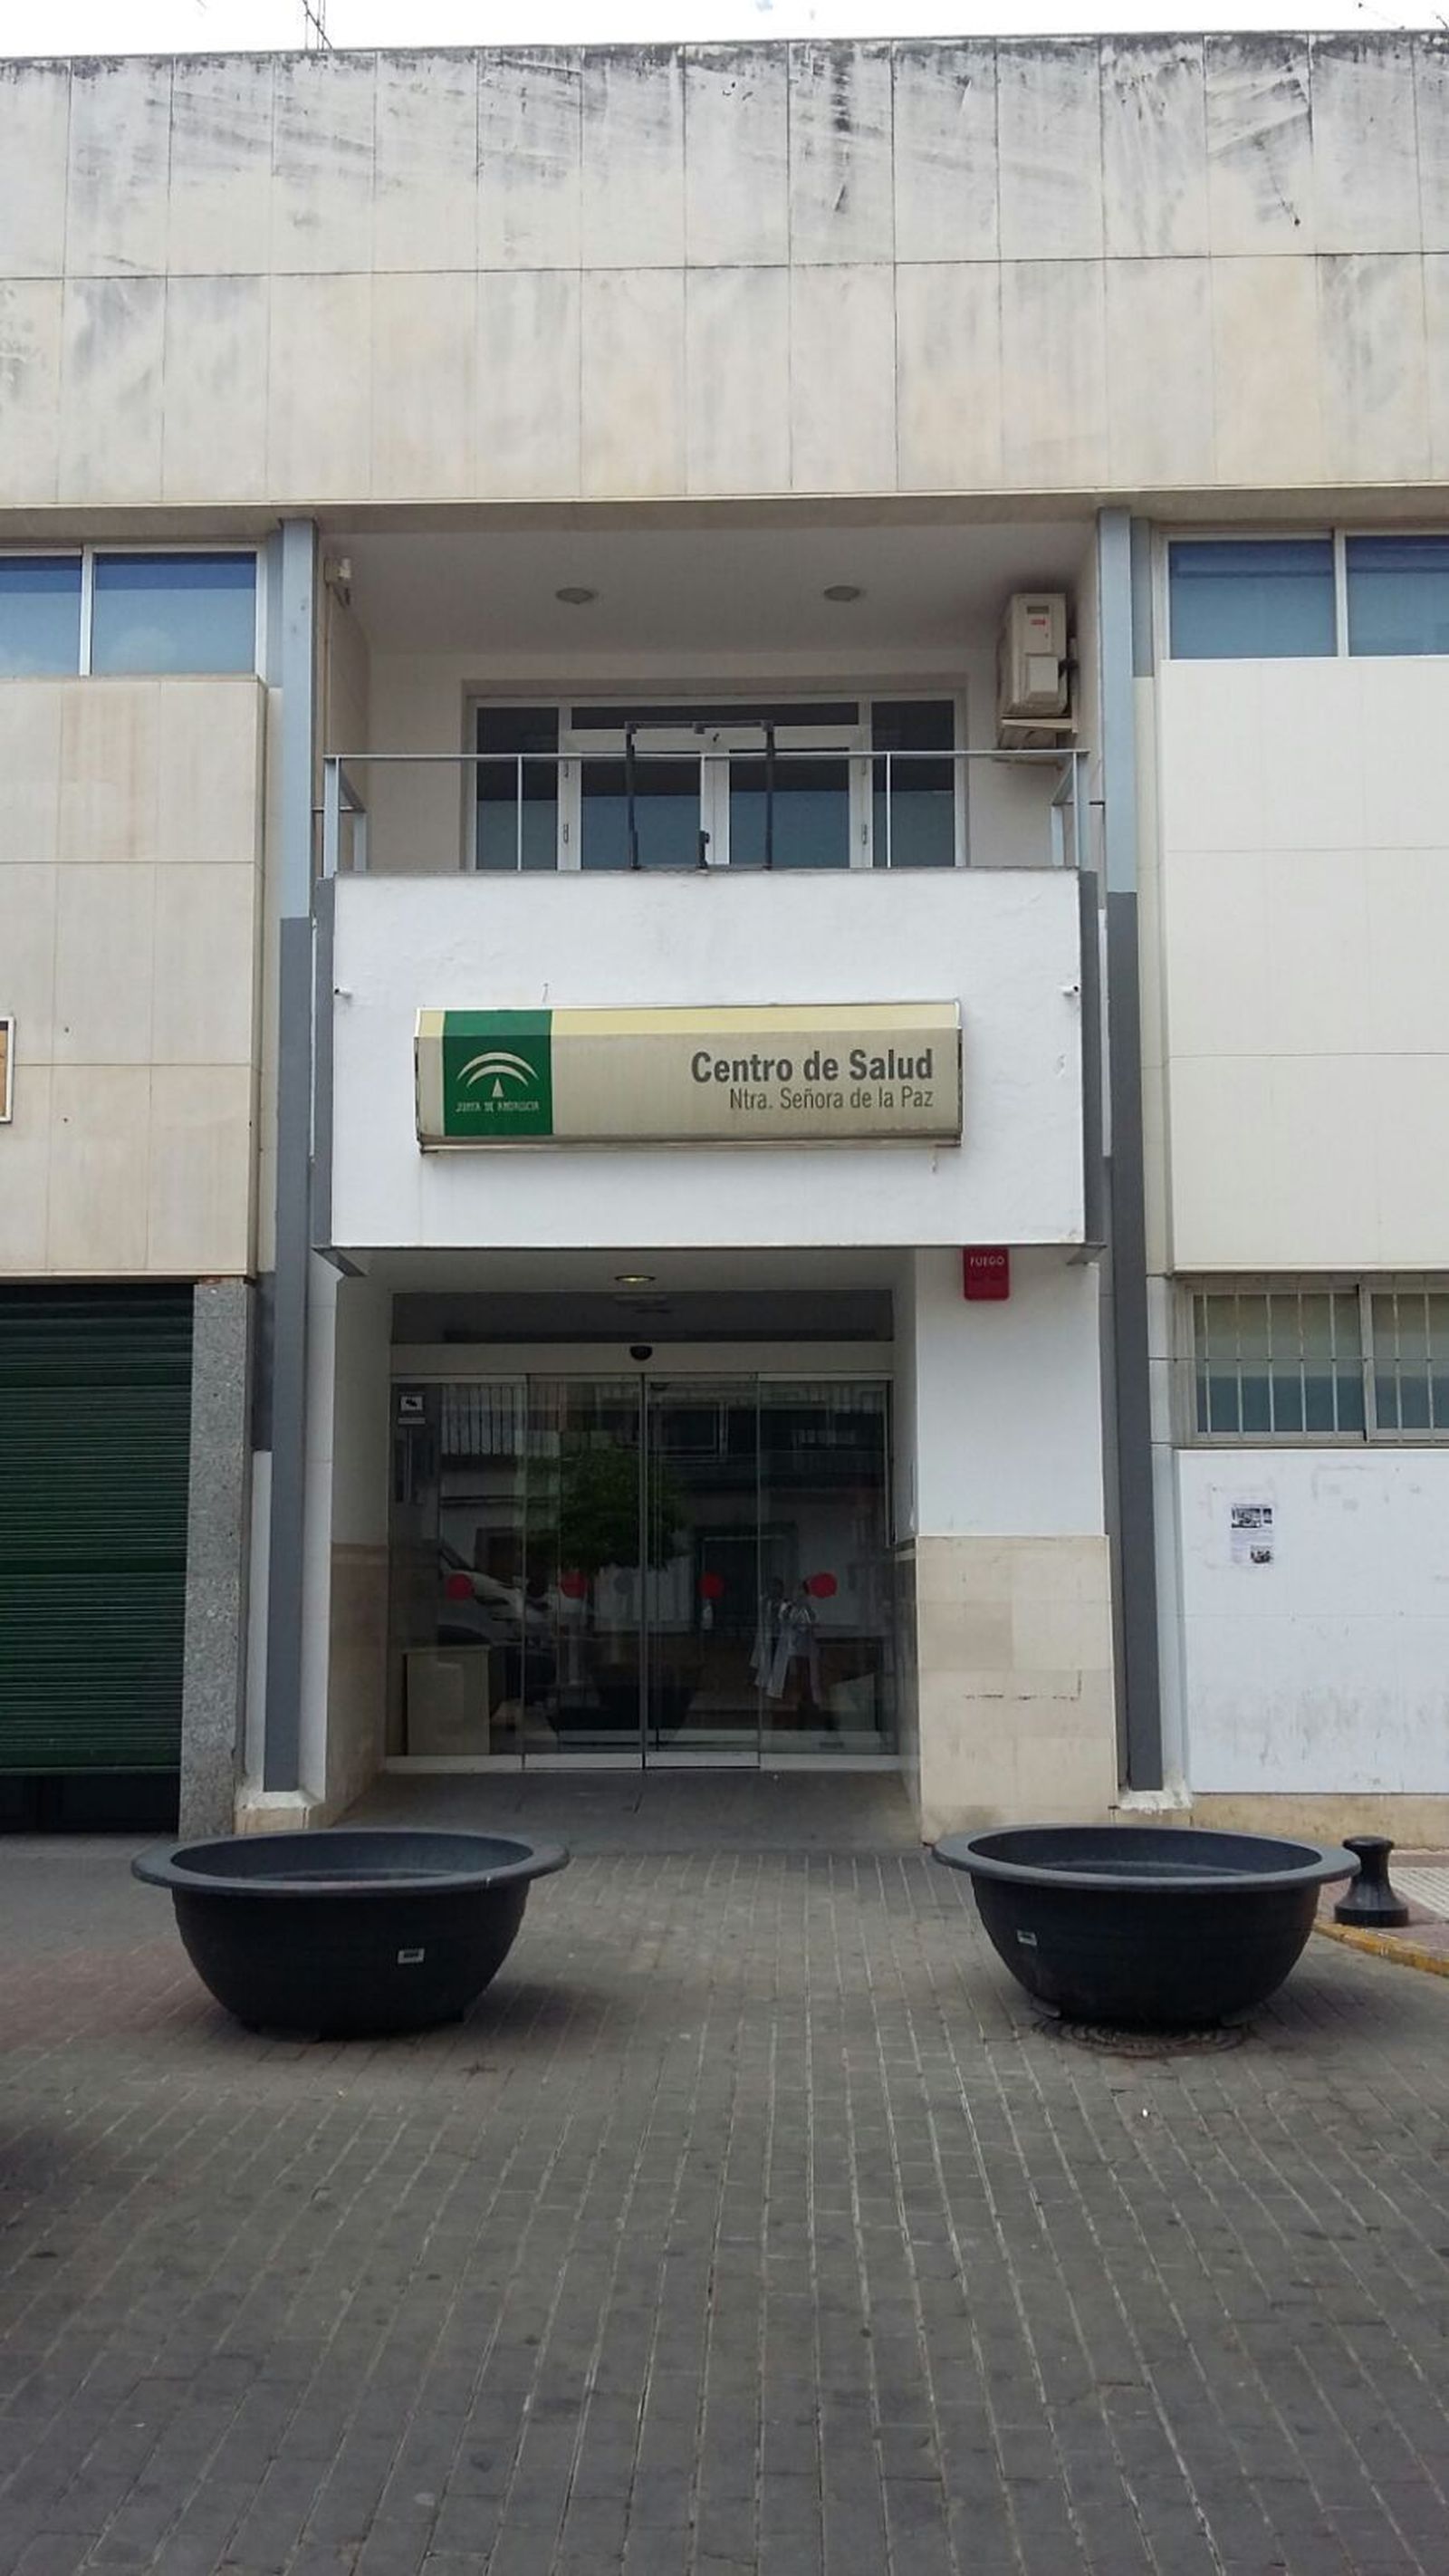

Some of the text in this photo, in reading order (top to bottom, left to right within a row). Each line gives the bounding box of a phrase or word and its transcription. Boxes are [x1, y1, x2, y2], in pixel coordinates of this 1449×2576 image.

[691, 1048, 933, 1083] Centro de Salud
[730, 1085, 934, 1110] Ntra. Señora de la Paz
[970, 1255, 1005, 1267] FUEGO
